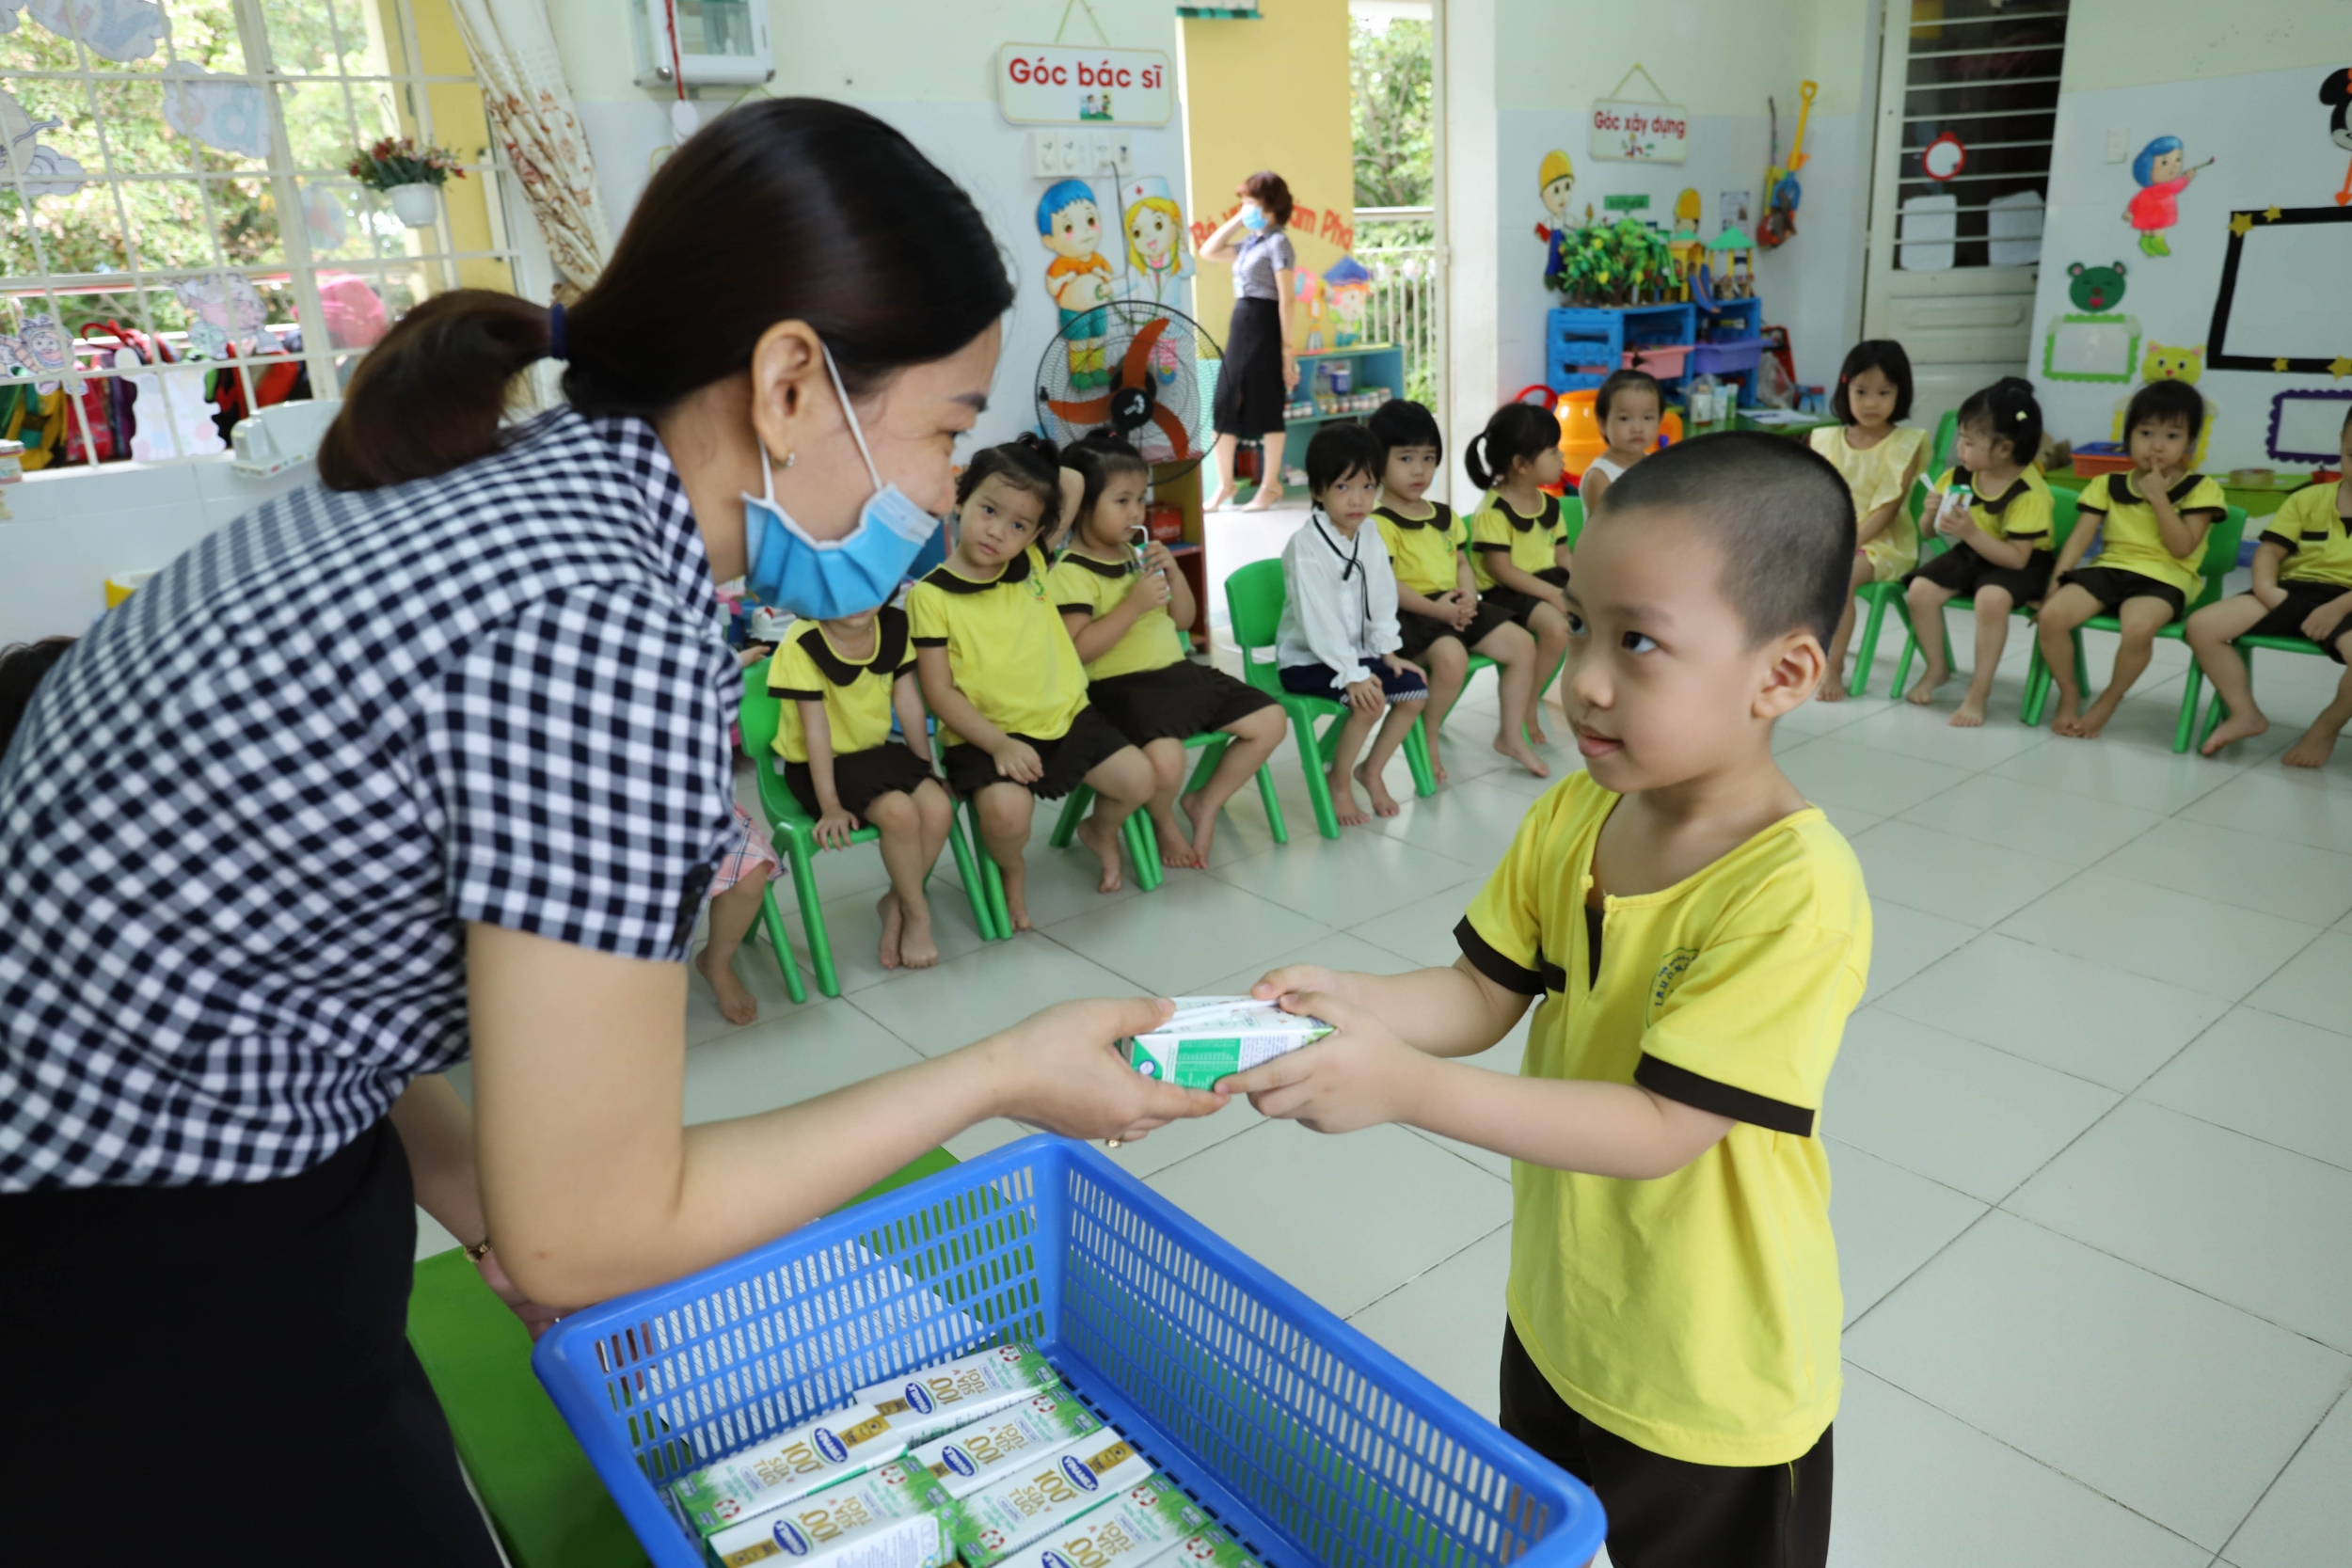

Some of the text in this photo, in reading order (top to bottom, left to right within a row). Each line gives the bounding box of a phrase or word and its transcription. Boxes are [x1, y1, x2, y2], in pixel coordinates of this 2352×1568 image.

[1009, 56, 1163, 88] Góc bác sĩ
[1594, 110, 1685, 139] Góc xây dựng
[1063, 1455, 1097, 1492] VINAMILK
